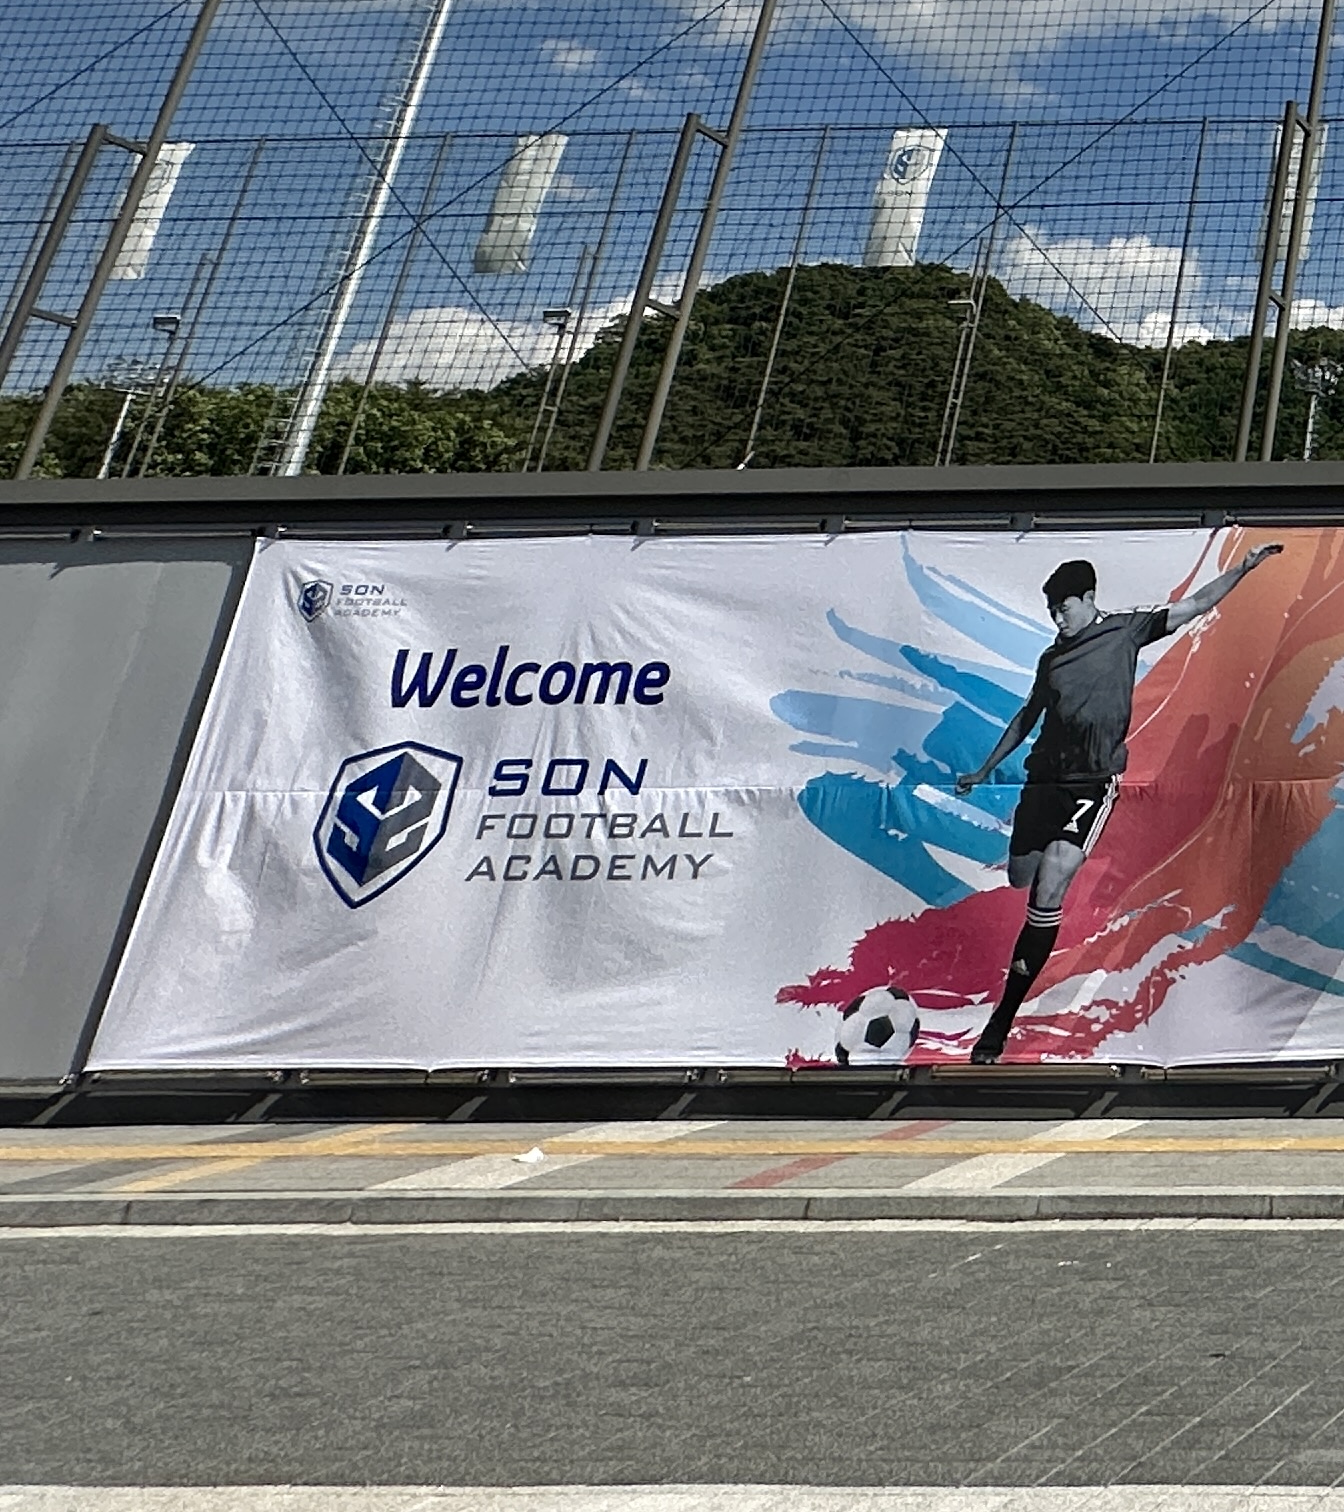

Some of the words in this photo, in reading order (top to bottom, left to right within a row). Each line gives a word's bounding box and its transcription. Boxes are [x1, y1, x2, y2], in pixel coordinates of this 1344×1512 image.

[336, 598, 408, 607] FOOTBALL
[339, 584, 385, 596] SON
[333, 609, 401, 618] ACADEMY
[390, 645, 671, 709] Welcome
[488, 758, 648, 798] SON
[1075, 798, 1095, 821] 7
[475, 812, 735, 840] FOOTBALL
[464, 853, 714, 882] ACADEMY
